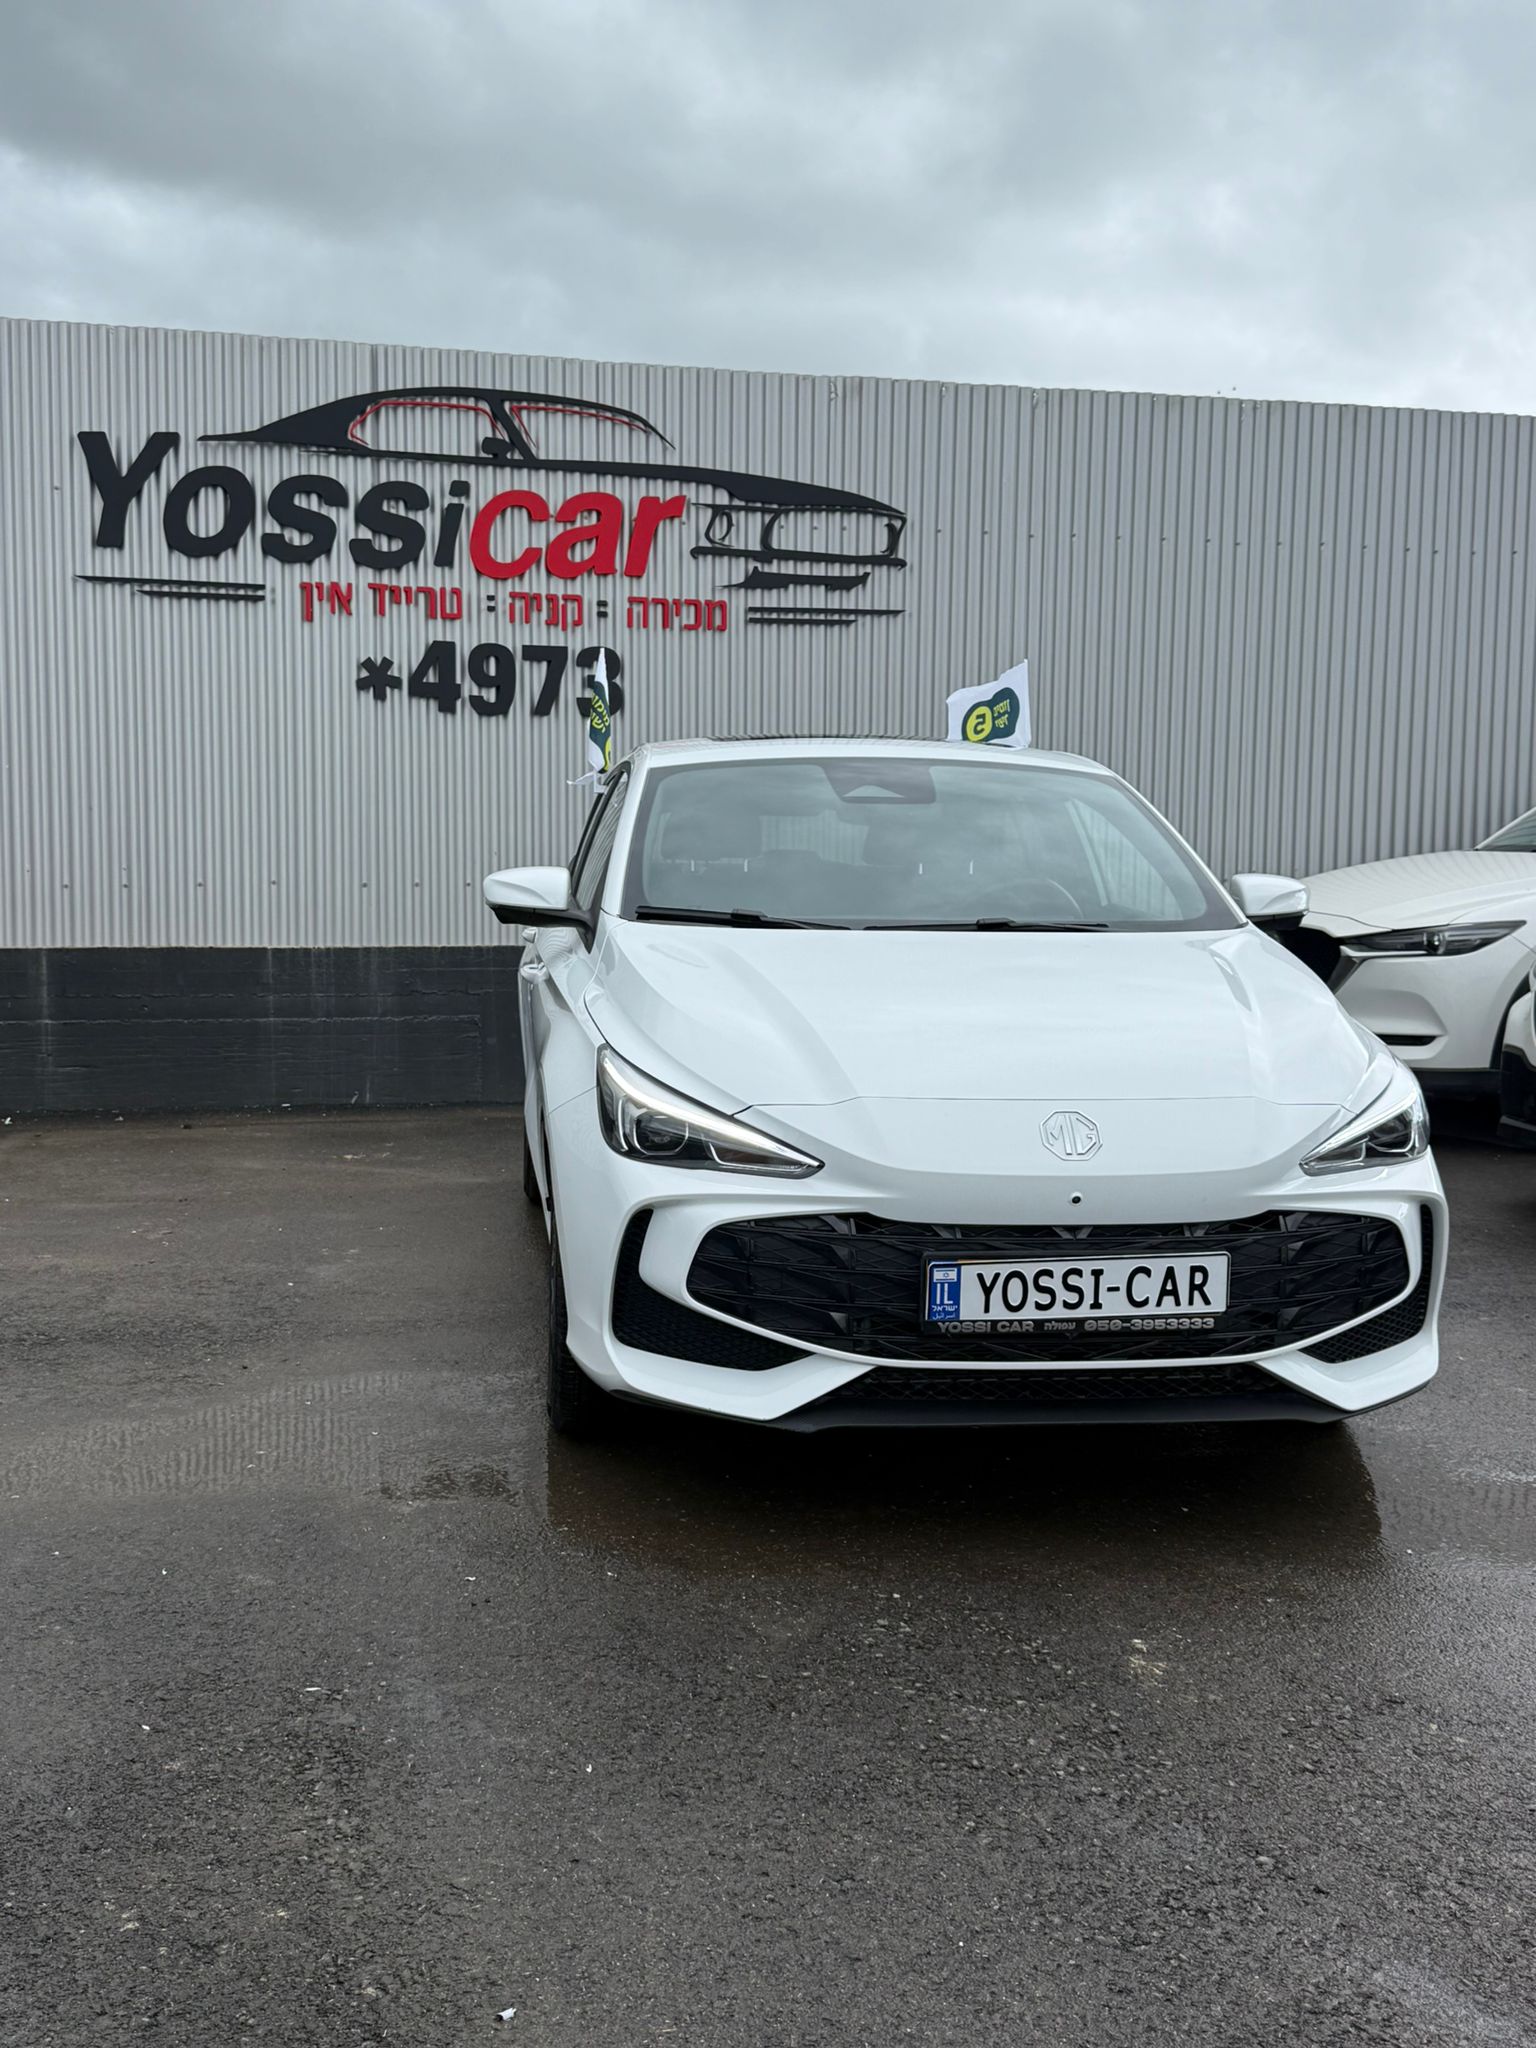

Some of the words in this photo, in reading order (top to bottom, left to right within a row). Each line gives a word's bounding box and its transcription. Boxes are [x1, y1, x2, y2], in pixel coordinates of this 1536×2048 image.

[300, 581, 353, 622] אין
[368, 583, 463, 620] טרייד
[509, 590, 583, 632] קניה
[627, 596, 728, 632] מכירה
[1044, 1113, 1098, 1157] MG
[931, 1304, 958, 1312] ישראל
[936, 1283, 954, 1304] IL
[976, 1265, 1212, 1314] YOSSI-CAR
[937, 1321, 992, 1333] YOSSI
[996, 1321, 1034, 1332] CAR
[1044, 1321, 1076, 1331] עפולה
[1084, 1317, 1215, 1331] 050-3953333
